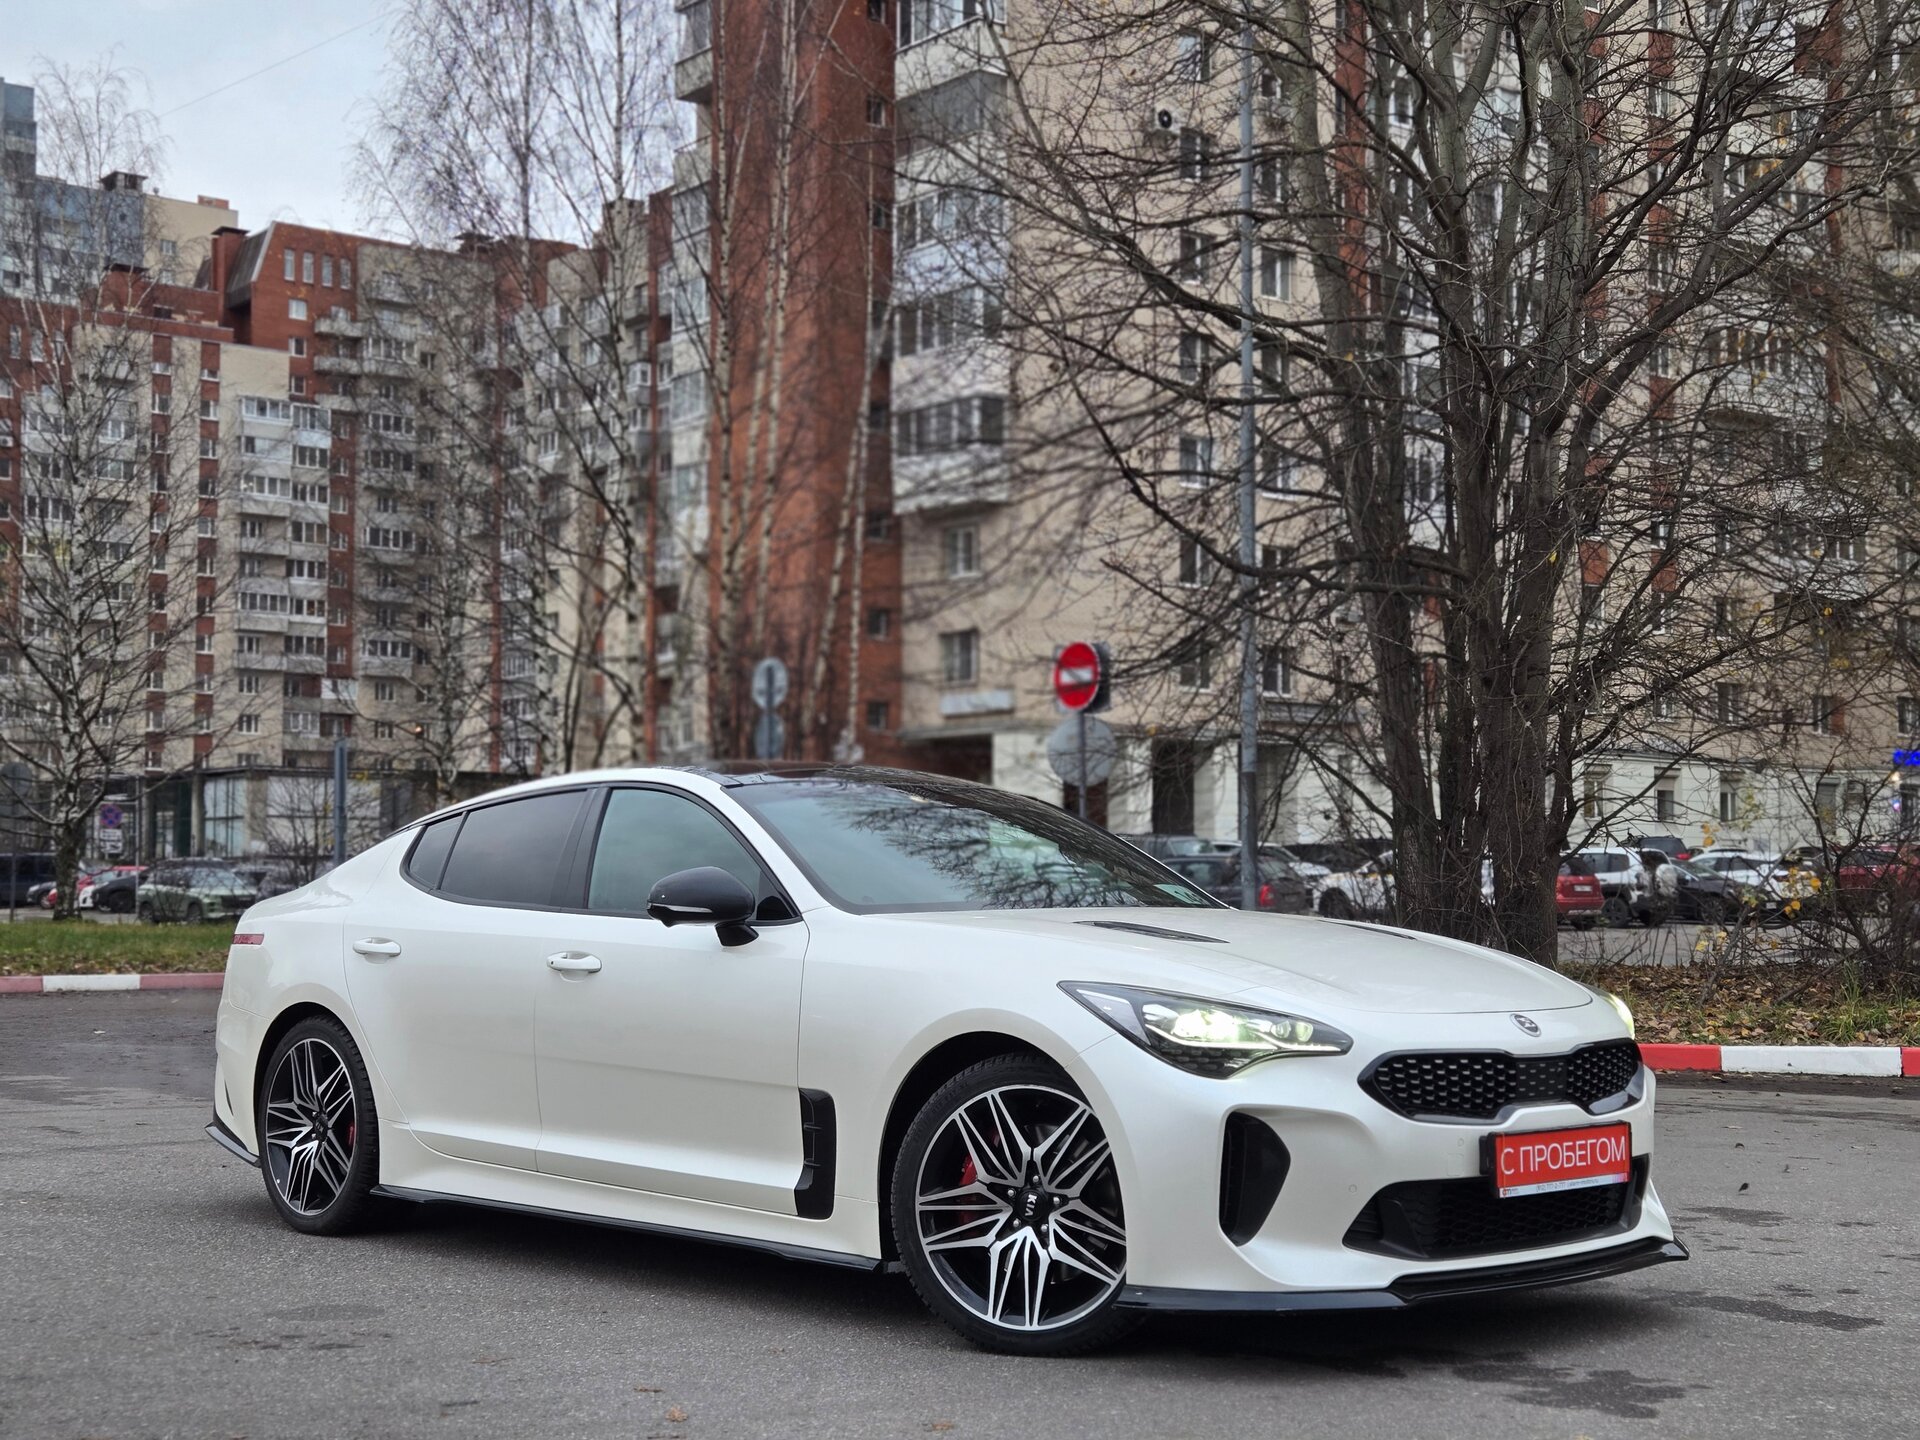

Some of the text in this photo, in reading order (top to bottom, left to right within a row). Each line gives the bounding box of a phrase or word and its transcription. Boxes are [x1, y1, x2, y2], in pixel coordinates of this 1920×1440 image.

[1501, 1135, 1626, 1175] С ПРОБЕГОМ
[1025, 1194, 1037, 1216] KIA
